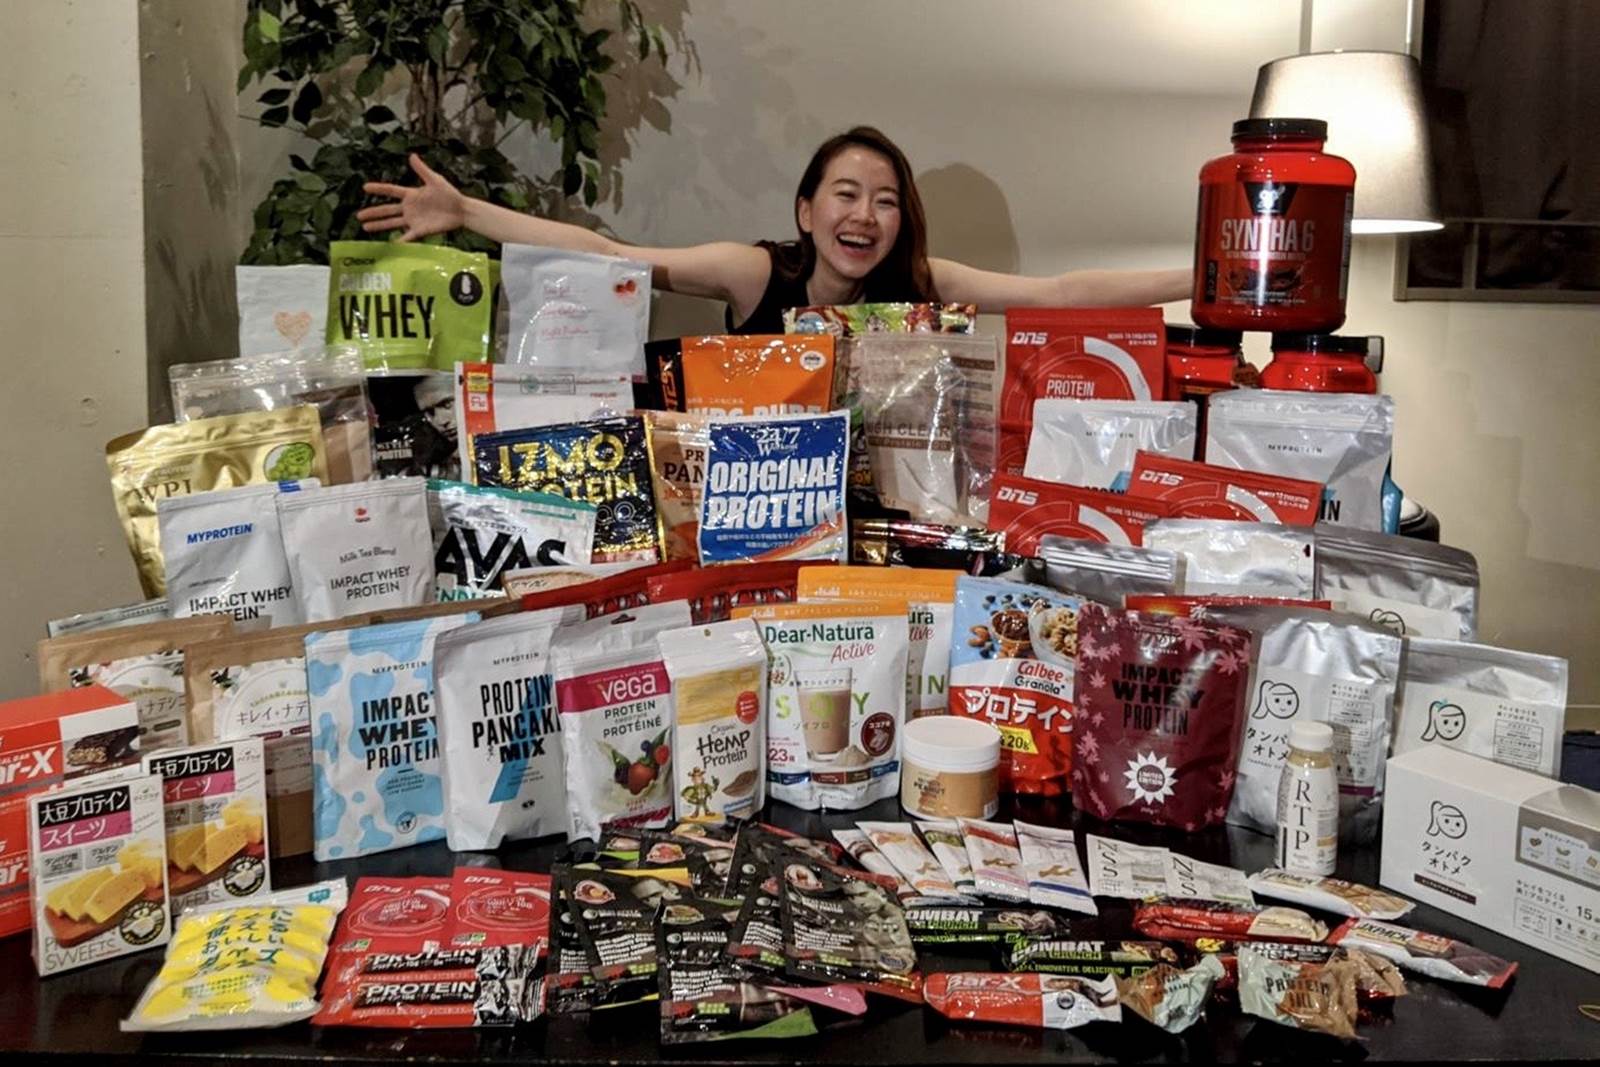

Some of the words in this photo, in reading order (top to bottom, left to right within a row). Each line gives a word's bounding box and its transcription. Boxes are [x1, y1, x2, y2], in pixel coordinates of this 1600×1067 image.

[1221, 218, 1297, 251] SYNTHA
[1303, 220, 1315, 250] 6
[339, 294, 435, 340] WHEY
[1012, 332, 1048, 345] DNS
[1046, 380, 1095, 396] PROTEIN
[498, 433, 626, 482] IZMO
[711, 456, 838, 493] ORIGINAL
[1139, 470, 1184, 486] DNS
[997, 486, 1039, 505] DNS
[706, 490, 838, 530] PROTEIN
[187, 523, 254, 544] MYPROTEIN
[435, 525, 568, 591] AVAS
[330, 573, 375, 589] IMPACT
[377, 566, 410, 581] WHEY
[189, 593, 247, 612] IMPACT
[250, 586, 292, 603] WHEY
[347, 581, 400, 600] PROTEIN
[765, 624, 875, 644] Dear-Natura
[909, 626, 934, 642] tive
[493, 652, 539, 665] MYPROTEIN
[831, 643, 876, 664] Active
[1018, 661, 1064, 683] Calbee
[481, 674, 553, 717] PROTEIN
[602, 673, 657, 704] vega
[1014, 676, 1061, 695] Granola
[1112, 680, 1205, 709] WHEY
[237, 700, 309, 725] キレイ・ナデ
[362, 690, 435, 723] IMPAC
[605, 700, 656, 719] PROTEIN
[964, 688, 1073, 733] プロテイン
[603, 716, 662, 738] PROTÉINÉ
[1123, 703, 1189, 736] PROTEIN
[1246, 727, 1288, 745] タンパ
[500, 738, 545, 763] MIX
[703, 749, 748, 769] Protein
[0, 746, 56, 785] ar-X
[164, 777, 212, 800] イーツ
[40, 790, 129, 826] 大豆プロテイン
[42, 818, 107, 848] スイーツ
[1421, 840, 1472, 867] タンパク
[1428, 857, 1461, 876] オトメ
[904, 909, 983, 923] OMBAT
[1576, 905, 1593, 921] 15
[373, 948, 479, 967] PROTEIN
[365, 981, 477, 998] PROTEIN
[948, 974, 1023, 990] Bar-X
